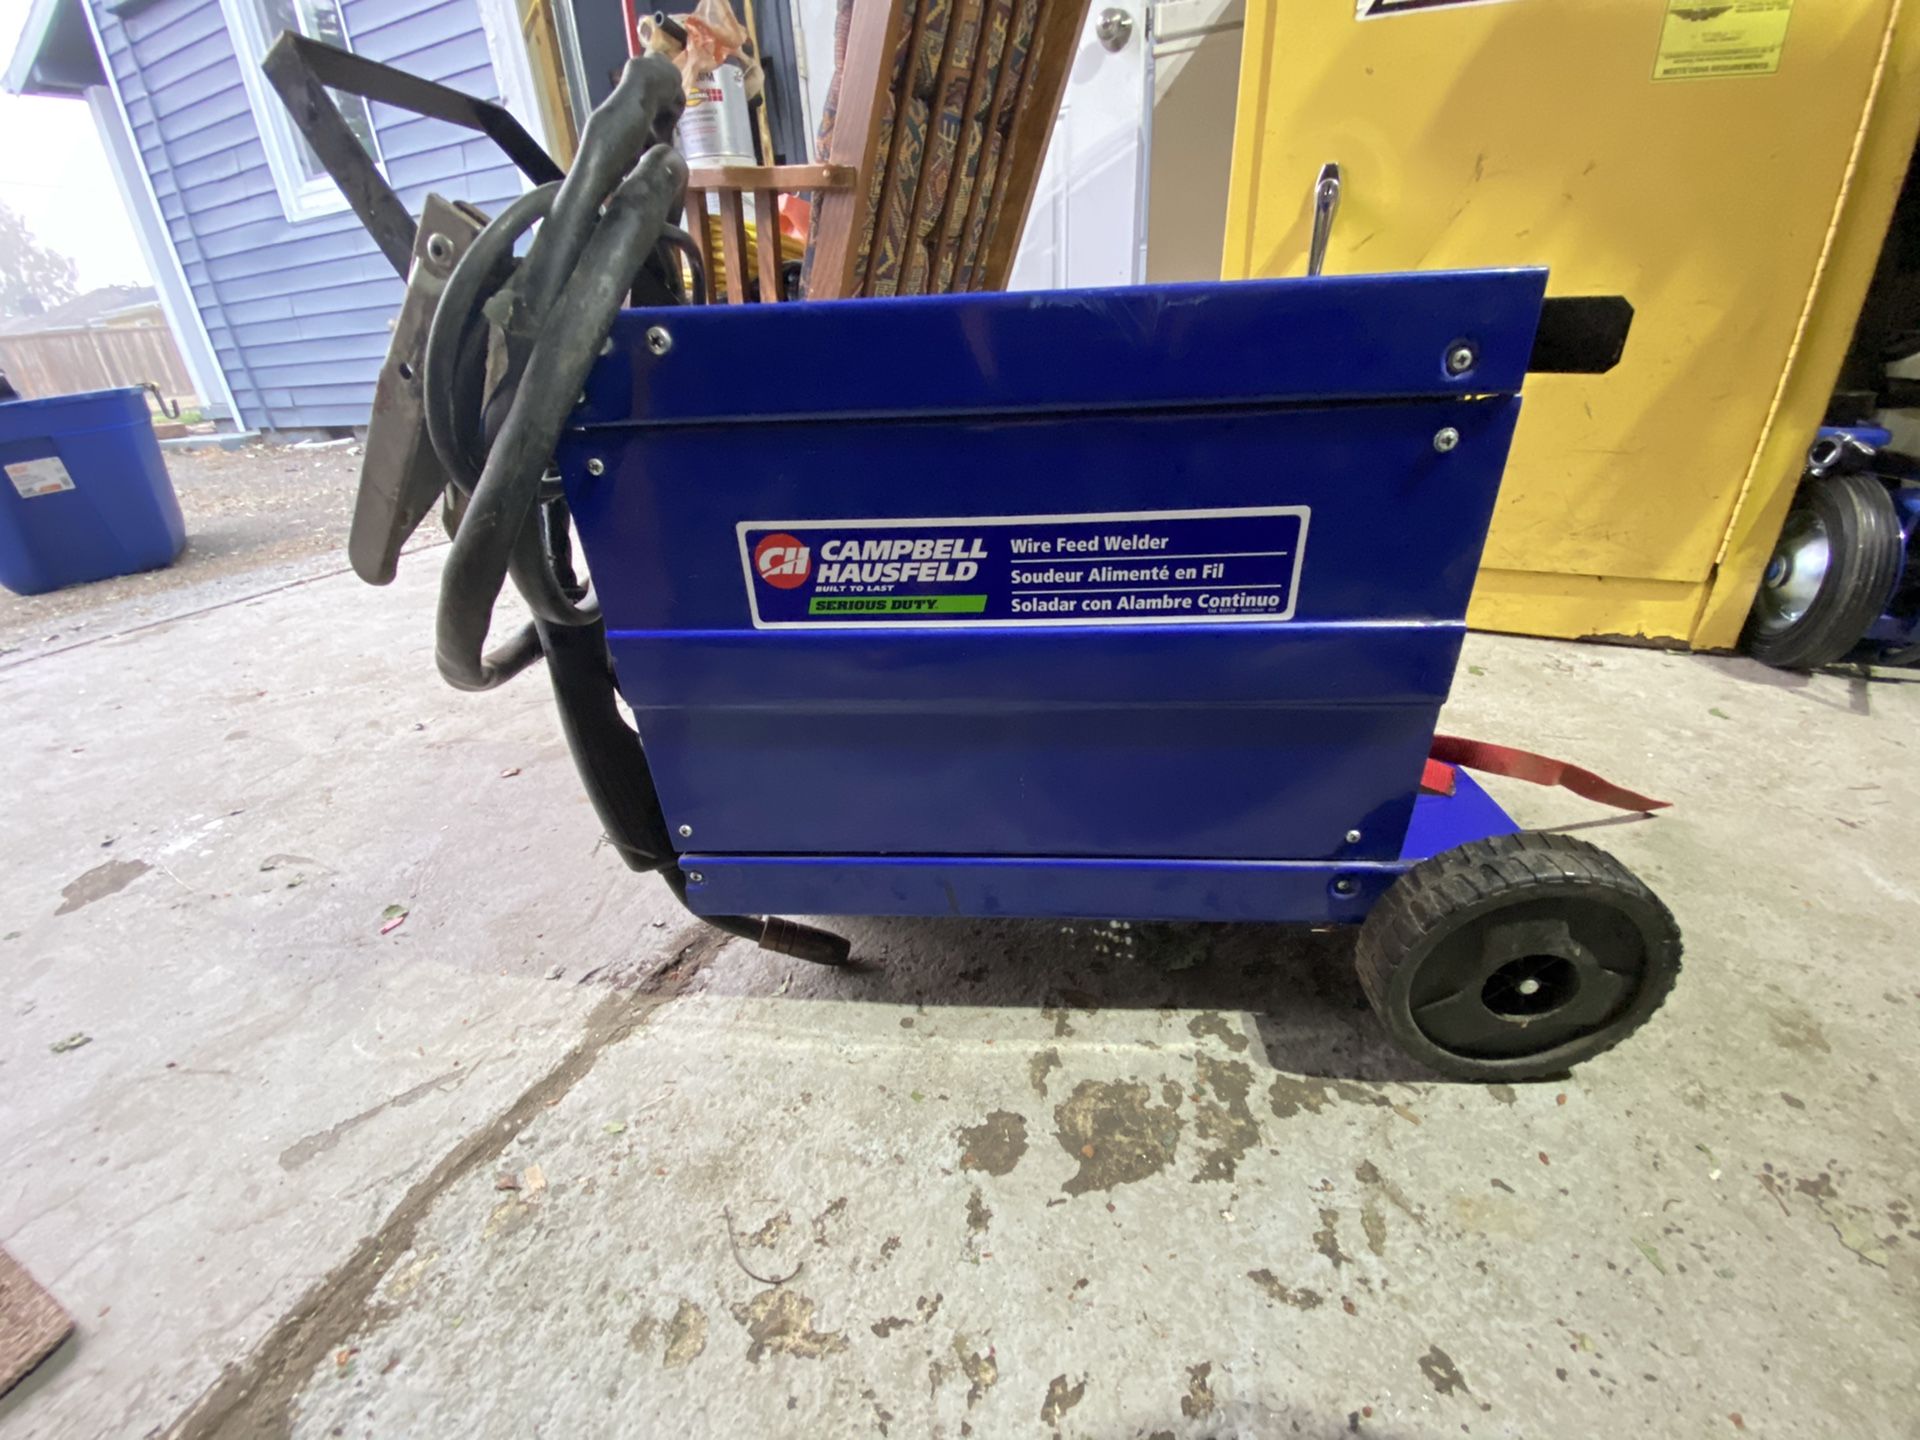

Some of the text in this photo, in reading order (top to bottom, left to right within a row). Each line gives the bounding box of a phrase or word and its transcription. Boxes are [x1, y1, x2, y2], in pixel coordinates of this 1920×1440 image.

[820, 538, 988, 561] CAMPBELL
[1010, 534, 1169, 553] Wire Feed Welder
[816, 561, 978, 583] HAUSFELD
[1011, 563, 1224, 584] Soudeur Alimenté en Fil
[816, 600, 938, 611] SERIOUS DUTY
[1011, 593, 1280, 612] Soladar con Alambre Continuo
